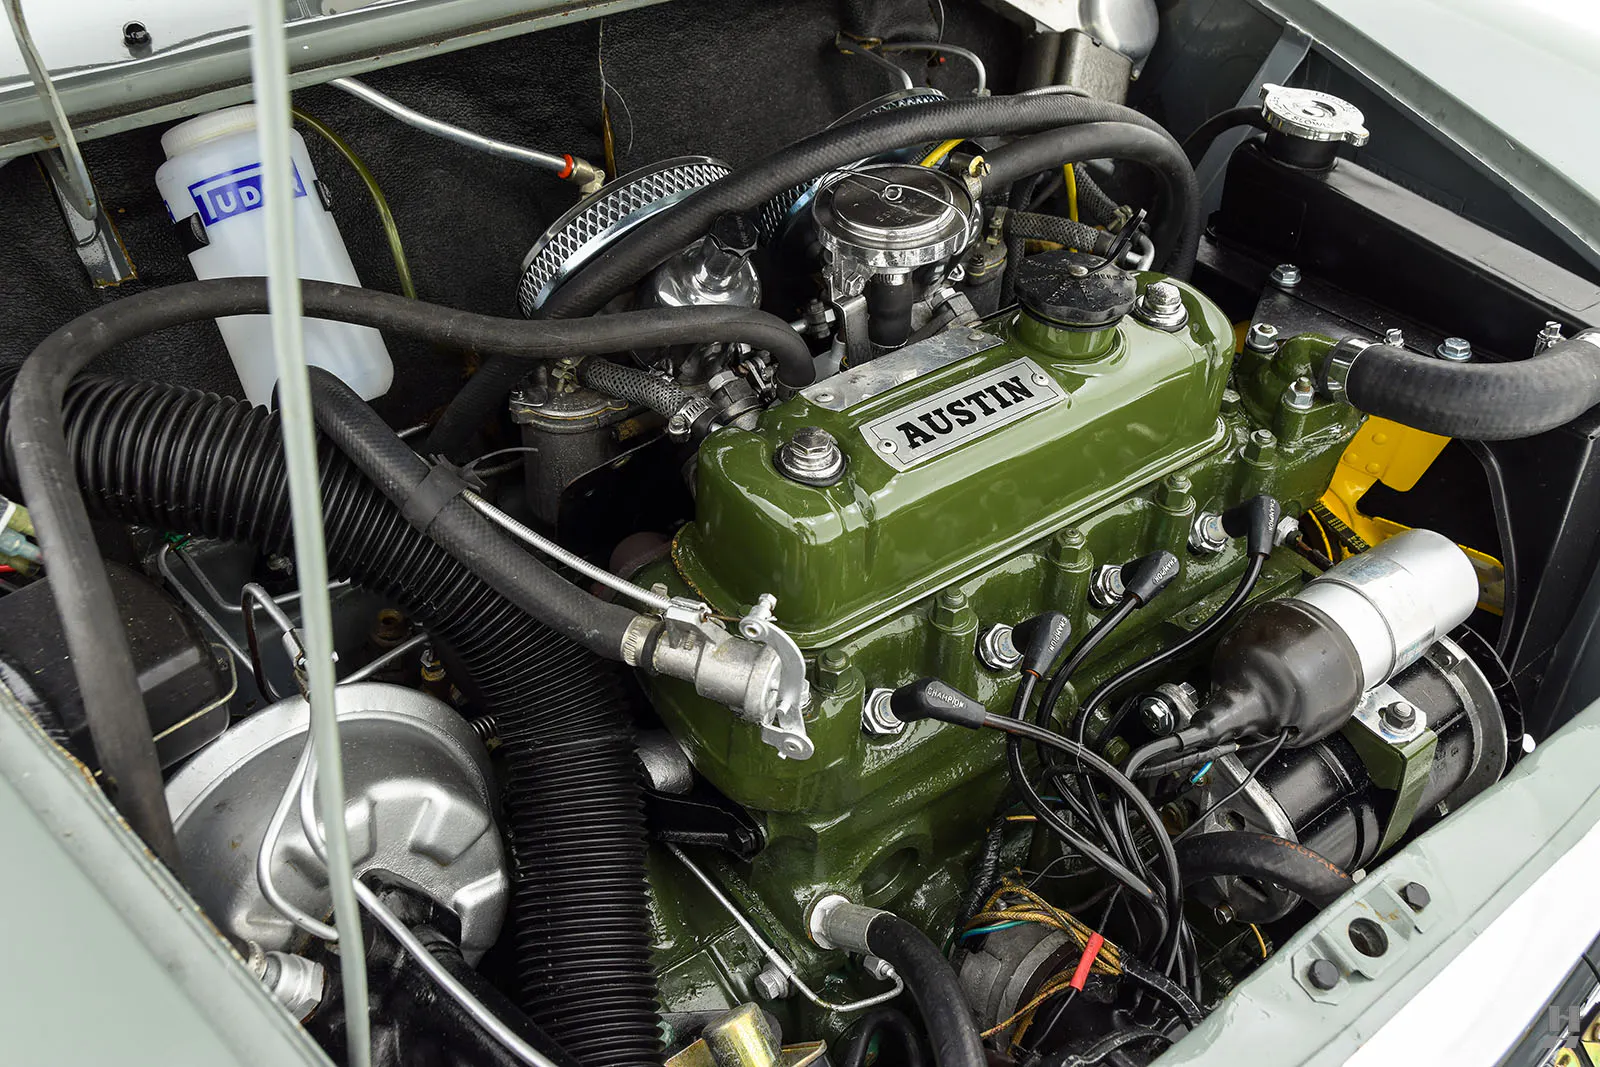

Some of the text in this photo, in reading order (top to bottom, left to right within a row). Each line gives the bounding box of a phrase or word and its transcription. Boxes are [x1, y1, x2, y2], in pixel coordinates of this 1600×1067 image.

[192, 164, 302, 220] TUD
[896, 375, 1035, 450] AUSTIN
[1268, 498, 1276, 531] CHAMPION
[1154, 556, 1178, 583] CHAMPION
[1048, 616, 1068, 652] CHAMPION
[926, 687, 965, 708] CHAMPION
